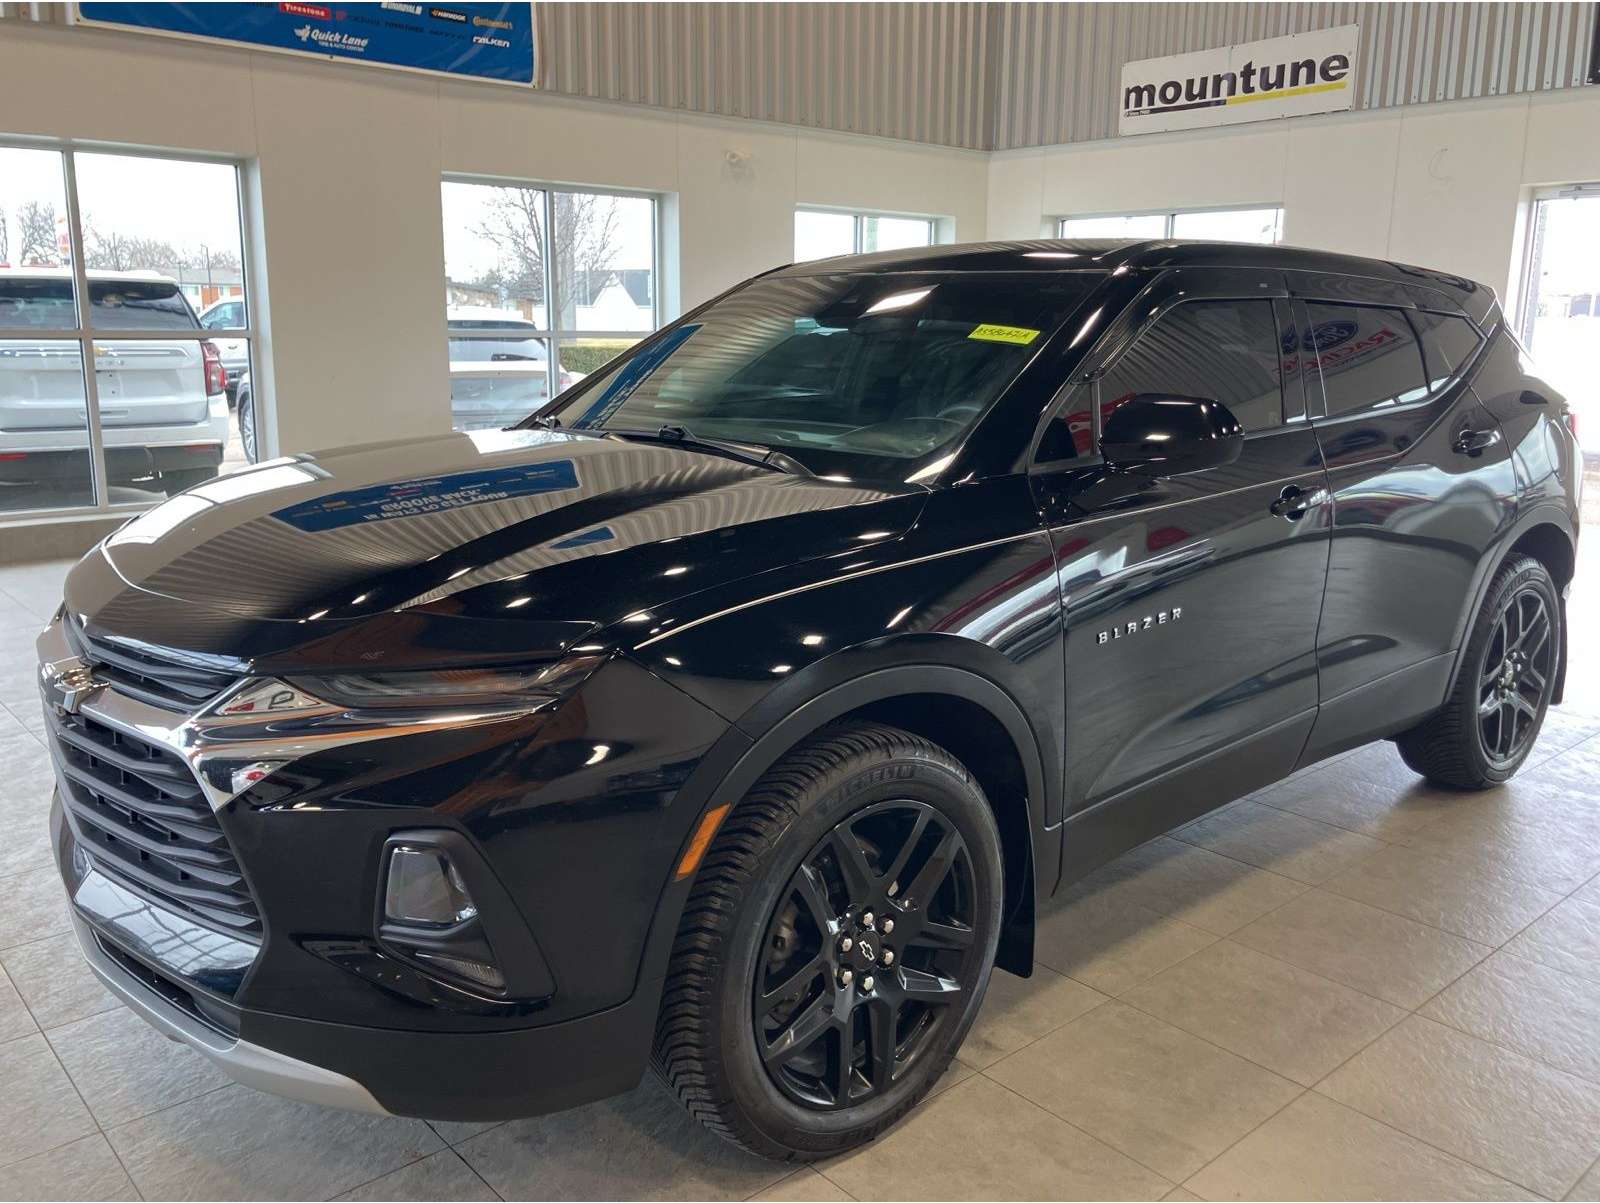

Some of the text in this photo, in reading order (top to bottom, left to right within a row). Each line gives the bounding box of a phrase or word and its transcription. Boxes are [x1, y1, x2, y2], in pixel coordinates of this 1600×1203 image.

[311, 28, 369, 47] Quick Lane
[1124, 53, 1349, 110] mountune
[1097, 607, 1181, 644] BLAZER
